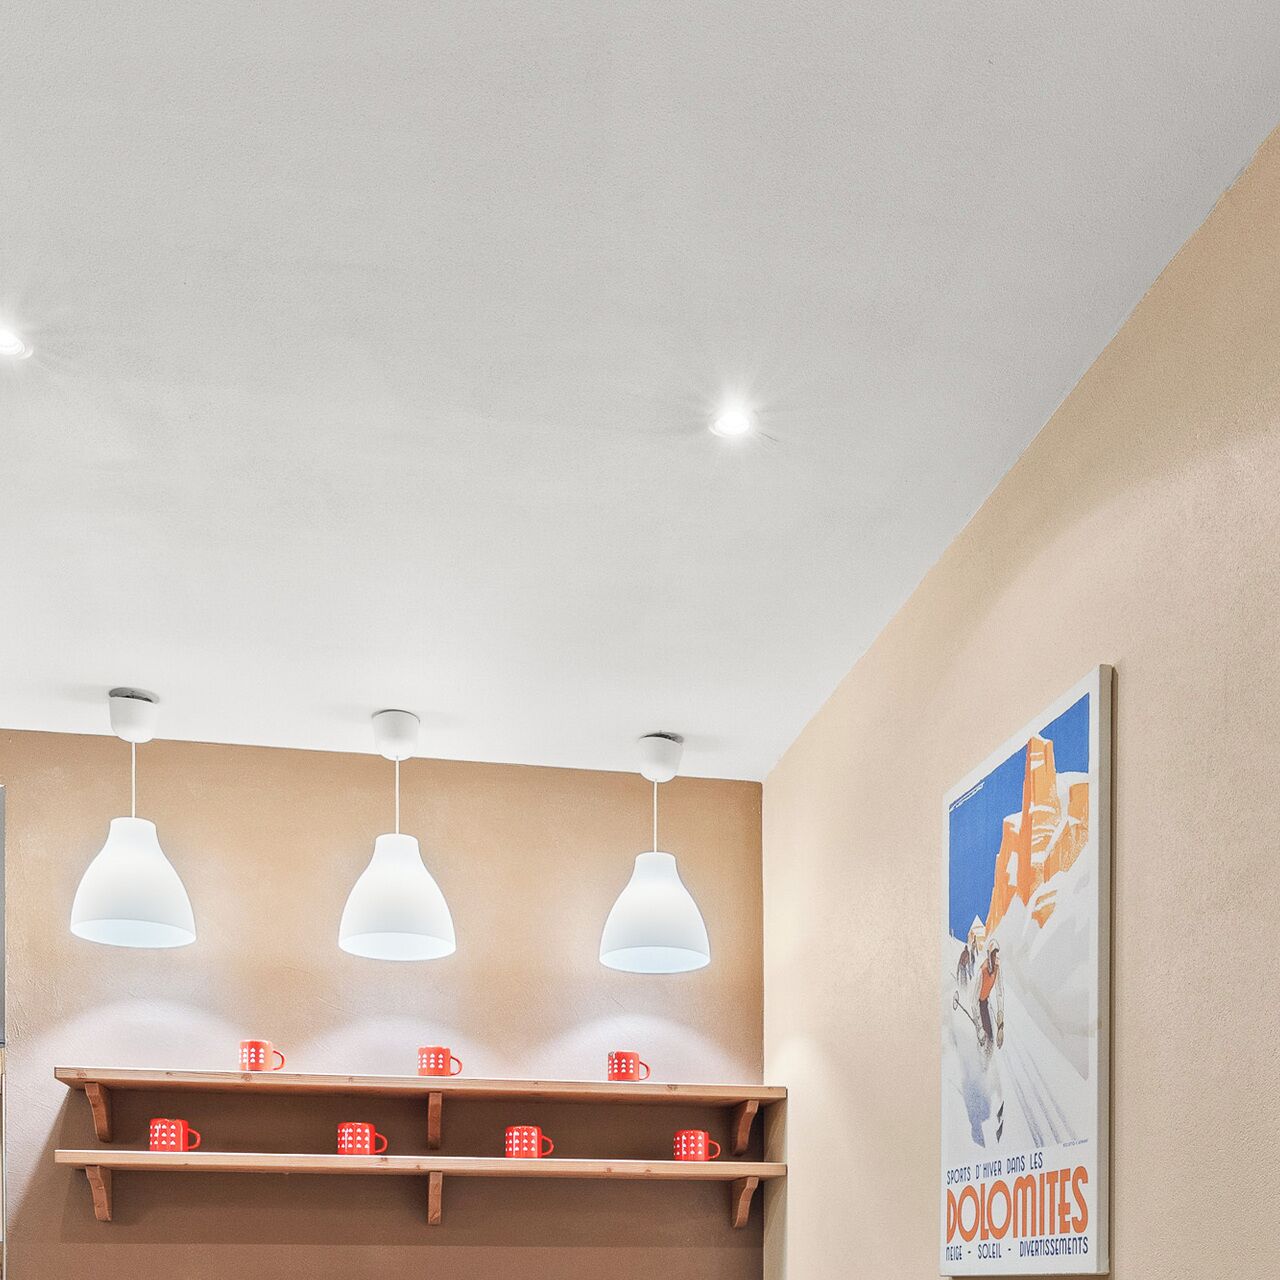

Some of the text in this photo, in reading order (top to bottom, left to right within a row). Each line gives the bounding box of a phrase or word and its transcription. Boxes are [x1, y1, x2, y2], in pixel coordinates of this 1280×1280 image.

[946, 1152, 1044, 1185] SPORTS D'HIVER DANS LES
[946, 1165, 1089, 1244] DOLOMITES
[946, 1245, 963, 1261] NEIGE
[977, 1242, 1002, 1260] SOLEIL
[1020, 1236, 1089, 1257] DIVERTISSEMENTS
